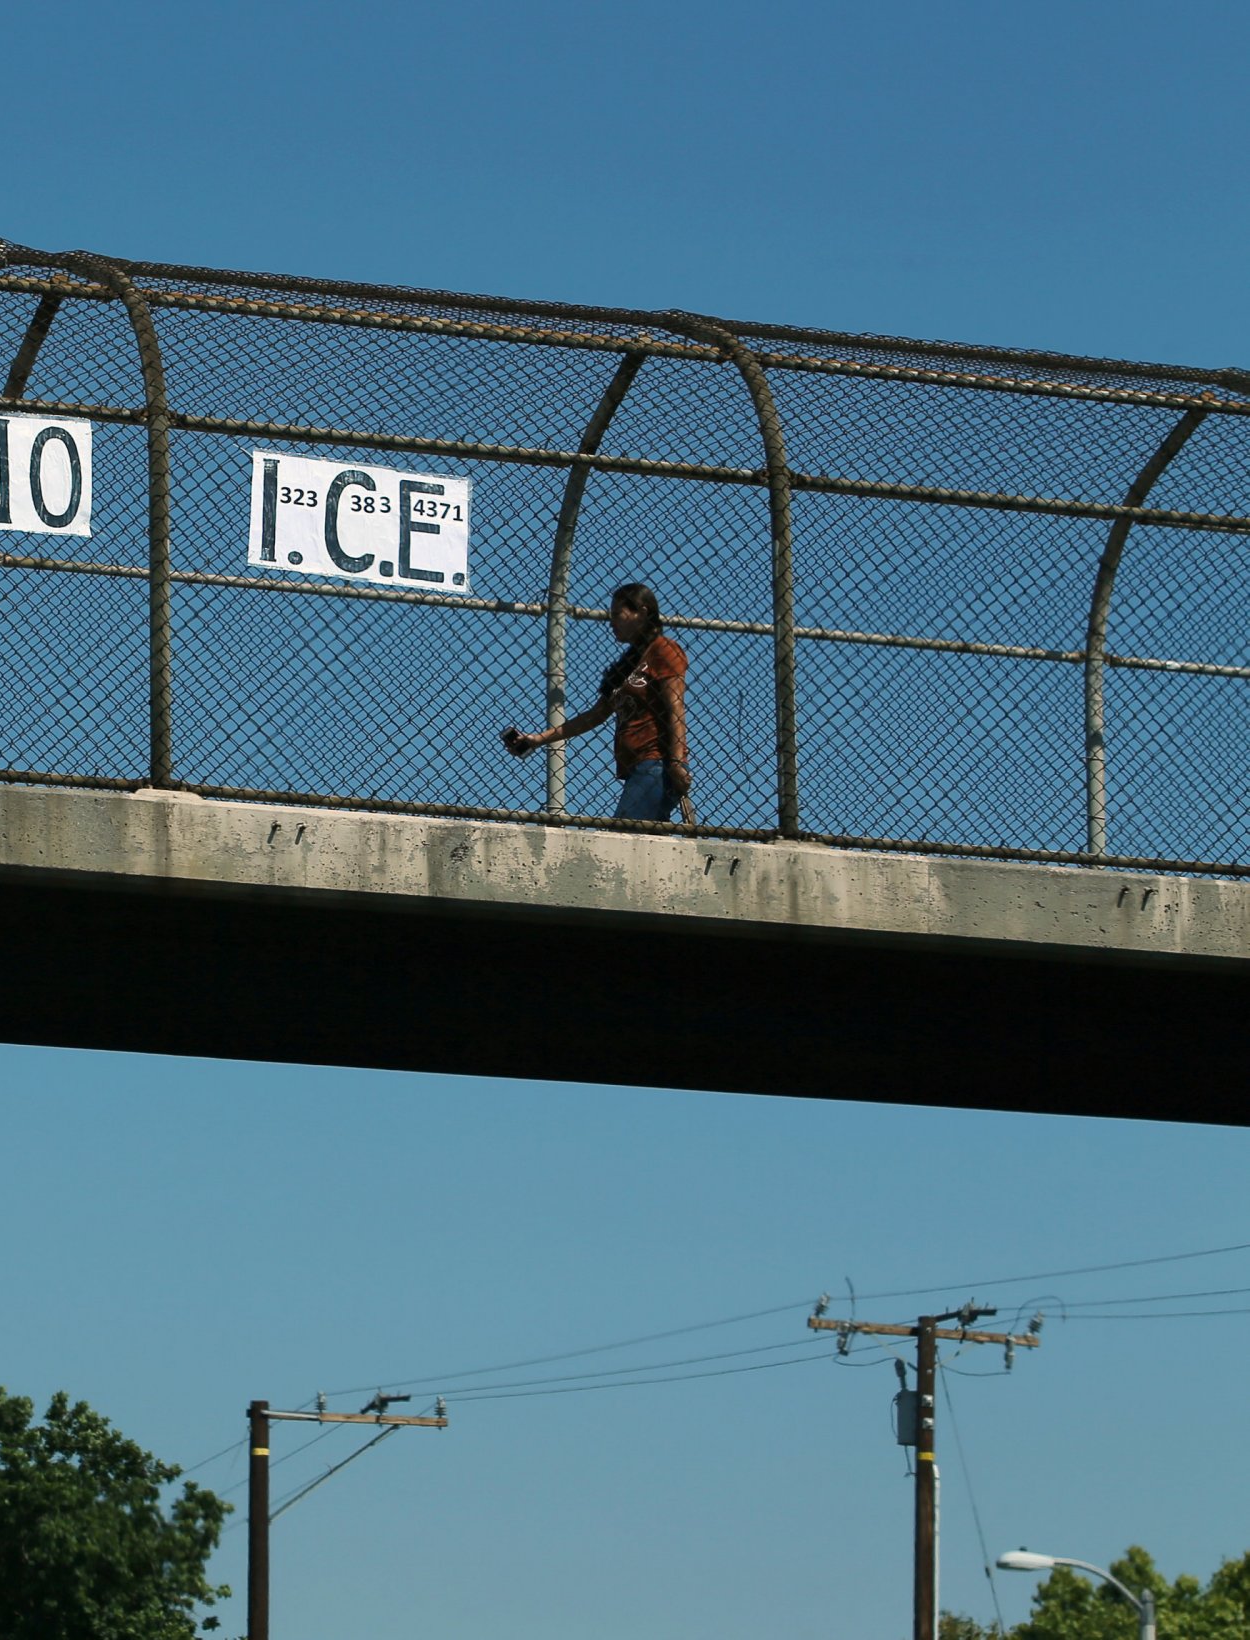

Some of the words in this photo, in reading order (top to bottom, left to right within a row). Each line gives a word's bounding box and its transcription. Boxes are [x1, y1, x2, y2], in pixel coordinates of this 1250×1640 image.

[260, 458, 465, 586] I.C.E.
[279, 486, 319, 507] 323
[350, 494, 391, 514] 383
[413, 499, 464, 522] 4371
